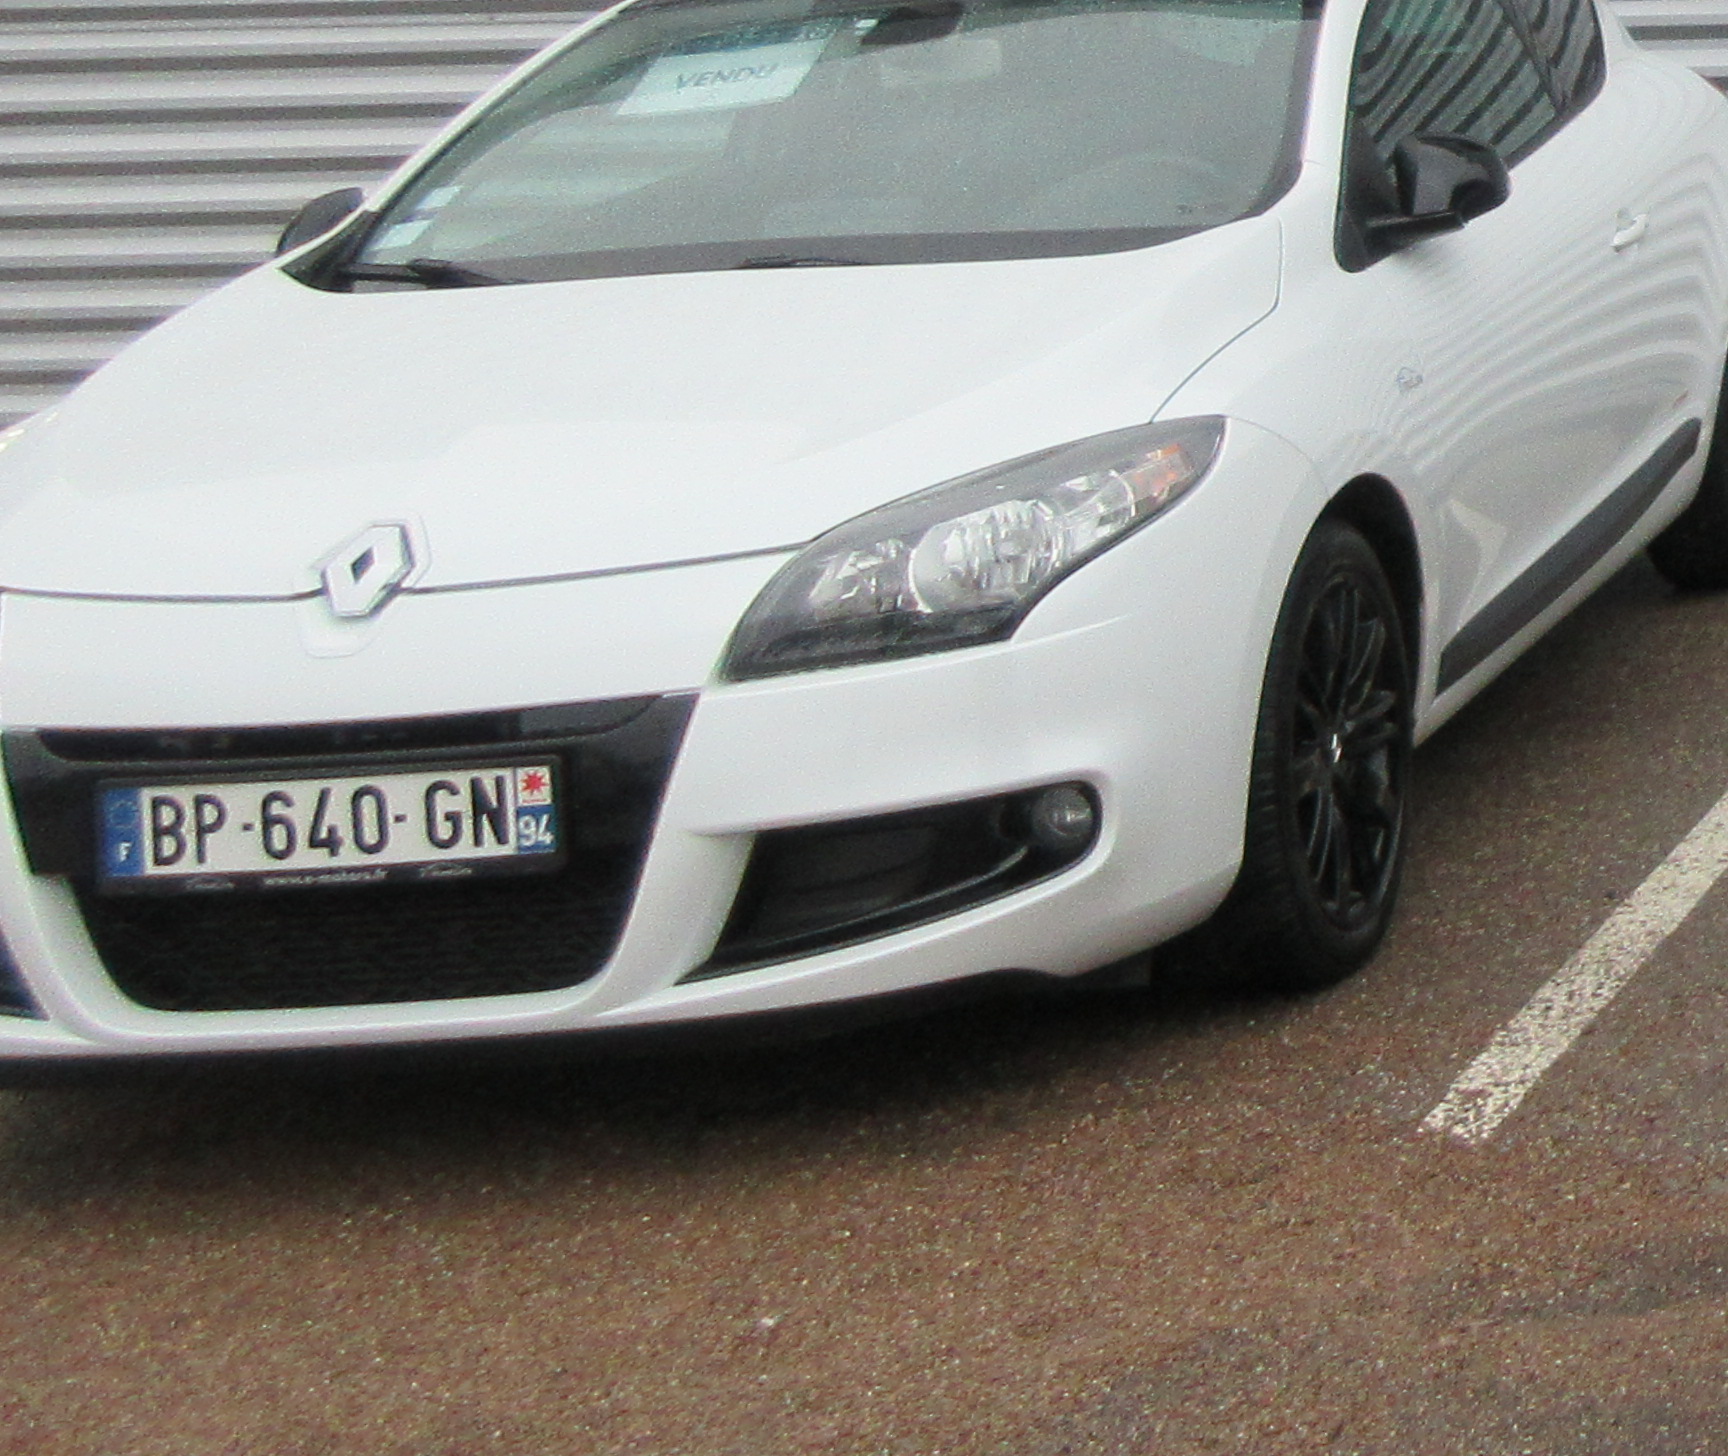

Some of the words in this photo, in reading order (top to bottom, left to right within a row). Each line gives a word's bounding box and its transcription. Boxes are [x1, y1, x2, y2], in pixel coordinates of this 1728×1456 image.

[676, 63, 779, 90] VENDU
[519, 813, 556, 847] 94
[118, 843, 131, 863] F
